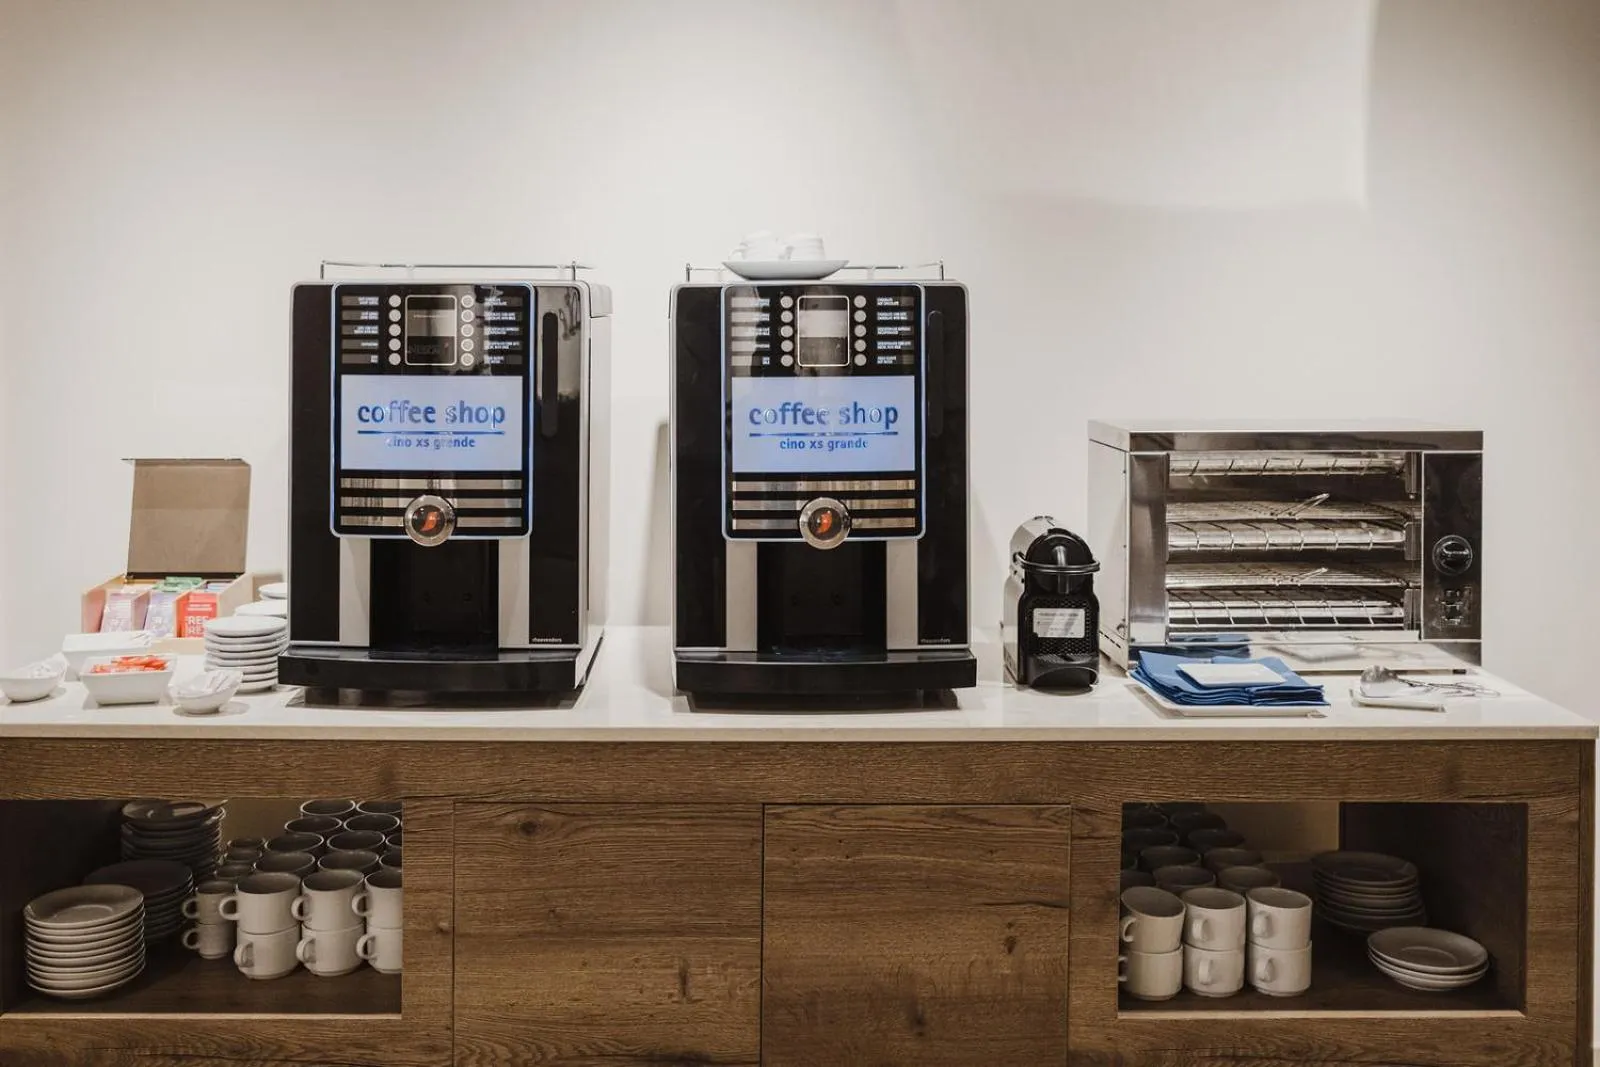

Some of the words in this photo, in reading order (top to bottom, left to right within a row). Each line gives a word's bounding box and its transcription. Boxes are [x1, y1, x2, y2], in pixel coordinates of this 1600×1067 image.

[358, 400, 436, 424] coffee
[445, 400, 506, 429] shop
[749, 402, 829, 425] coffee
[838, 401, 898, 430] shop
[386, 437, 411, 448] ino
[416, 439, 430, 448] xs
[780, 438, 806, 449] cino
[810, 440, 824, 449] xs
